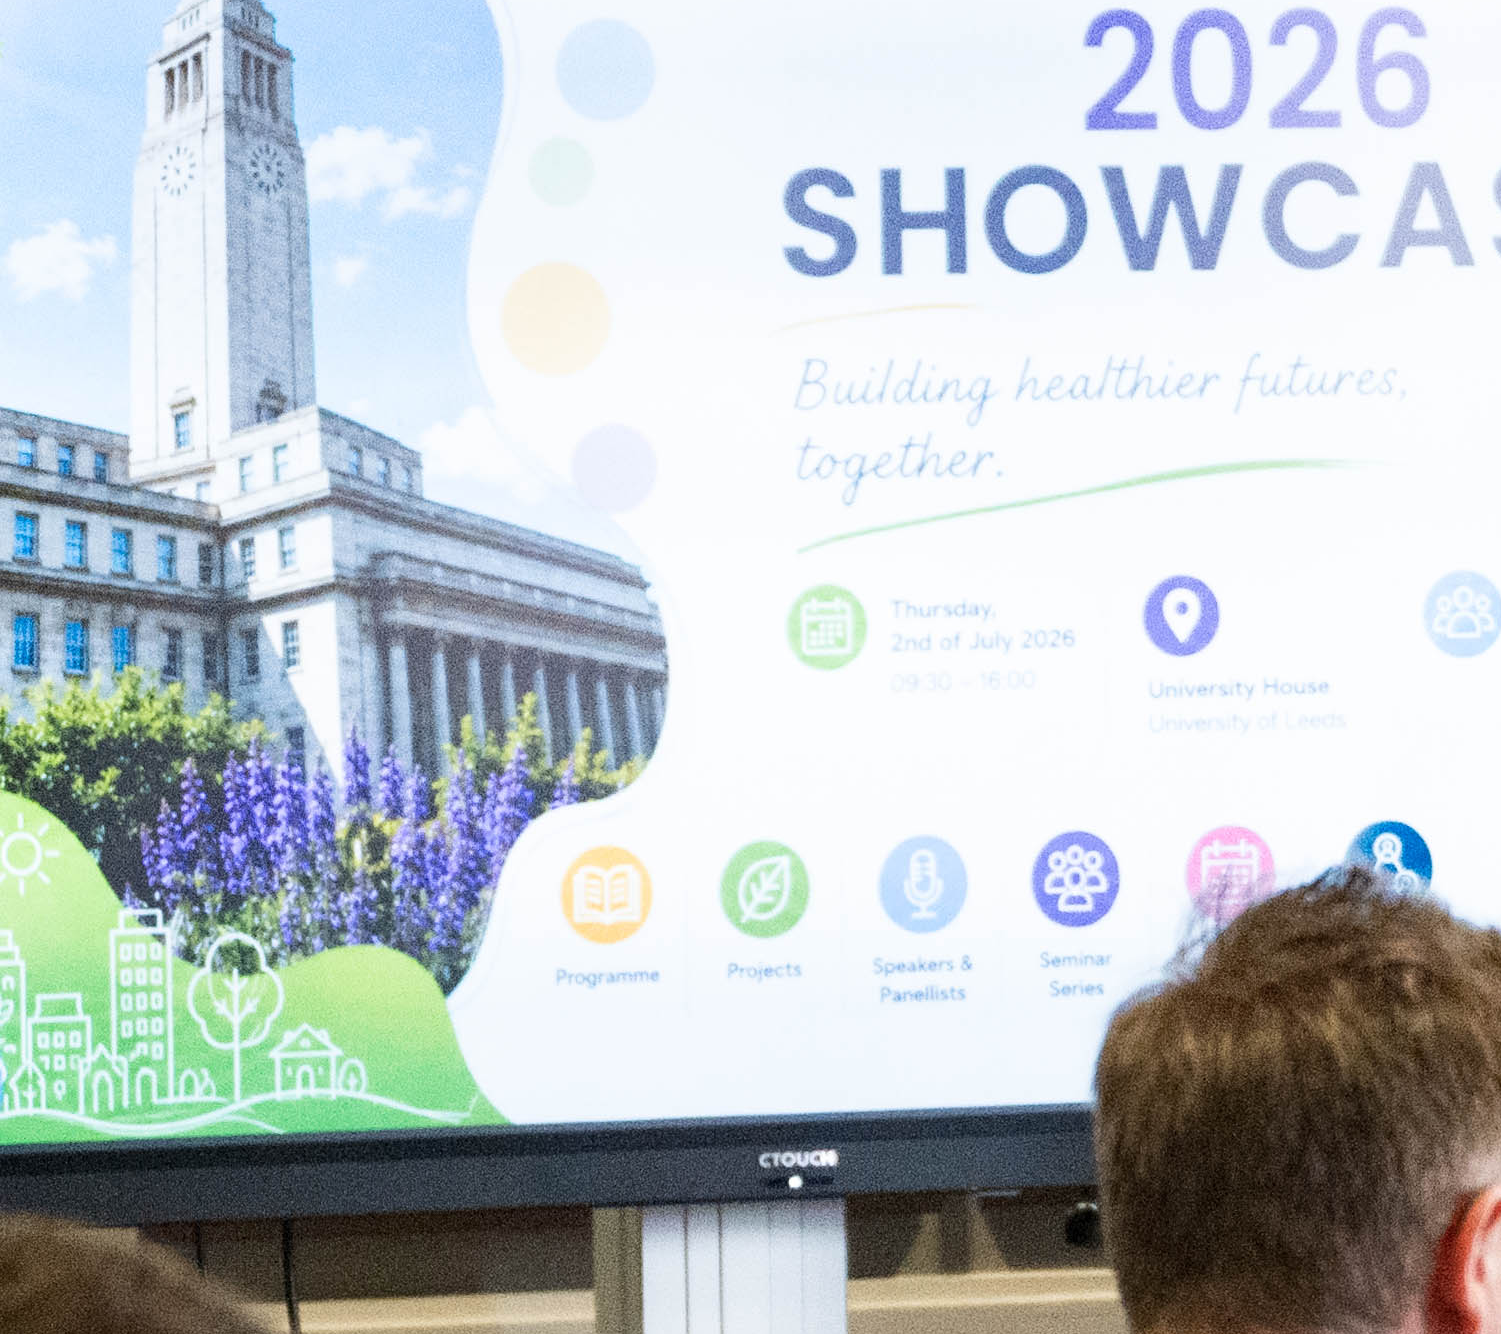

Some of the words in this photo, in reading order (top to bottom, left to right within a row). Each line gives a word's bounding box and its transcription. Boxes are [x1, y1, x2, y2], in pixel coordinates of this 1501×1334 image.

[1083, 7, 1430, 131] 2026
[793, 356, 998, 429] Building
[1013, 353, 1222, 404] healthier
[1231, 350, 1409, 415] futures,
[795, 430, 1005, 509] together.
[890, 598, 997, 622] Thursday,
[890, 632, 933, 653] 2nd
[940, 632, 963, 652] of
[968, 629, 1014, 655] July
[1020, 628, 1077, 650] 2026
[1148, 679, 1256, 701] University
[1262, 677, 1331, 697] House
[1148, 713, 1251, 736] University
[1256, 711, 1280, 731] of
[1285, 711, 1348, 731] Leeds
[872, 958, 955, 978] Speakers
[960, 954, 974, 971] &
[1039, 951, 1113, 969] Seminar
[555, 968, 661, 990] Programme
[726, 961, 804, 984] Projects
[879, 984, 967, 1004] Panellists
[1049, 980, 1105, 998] Series
